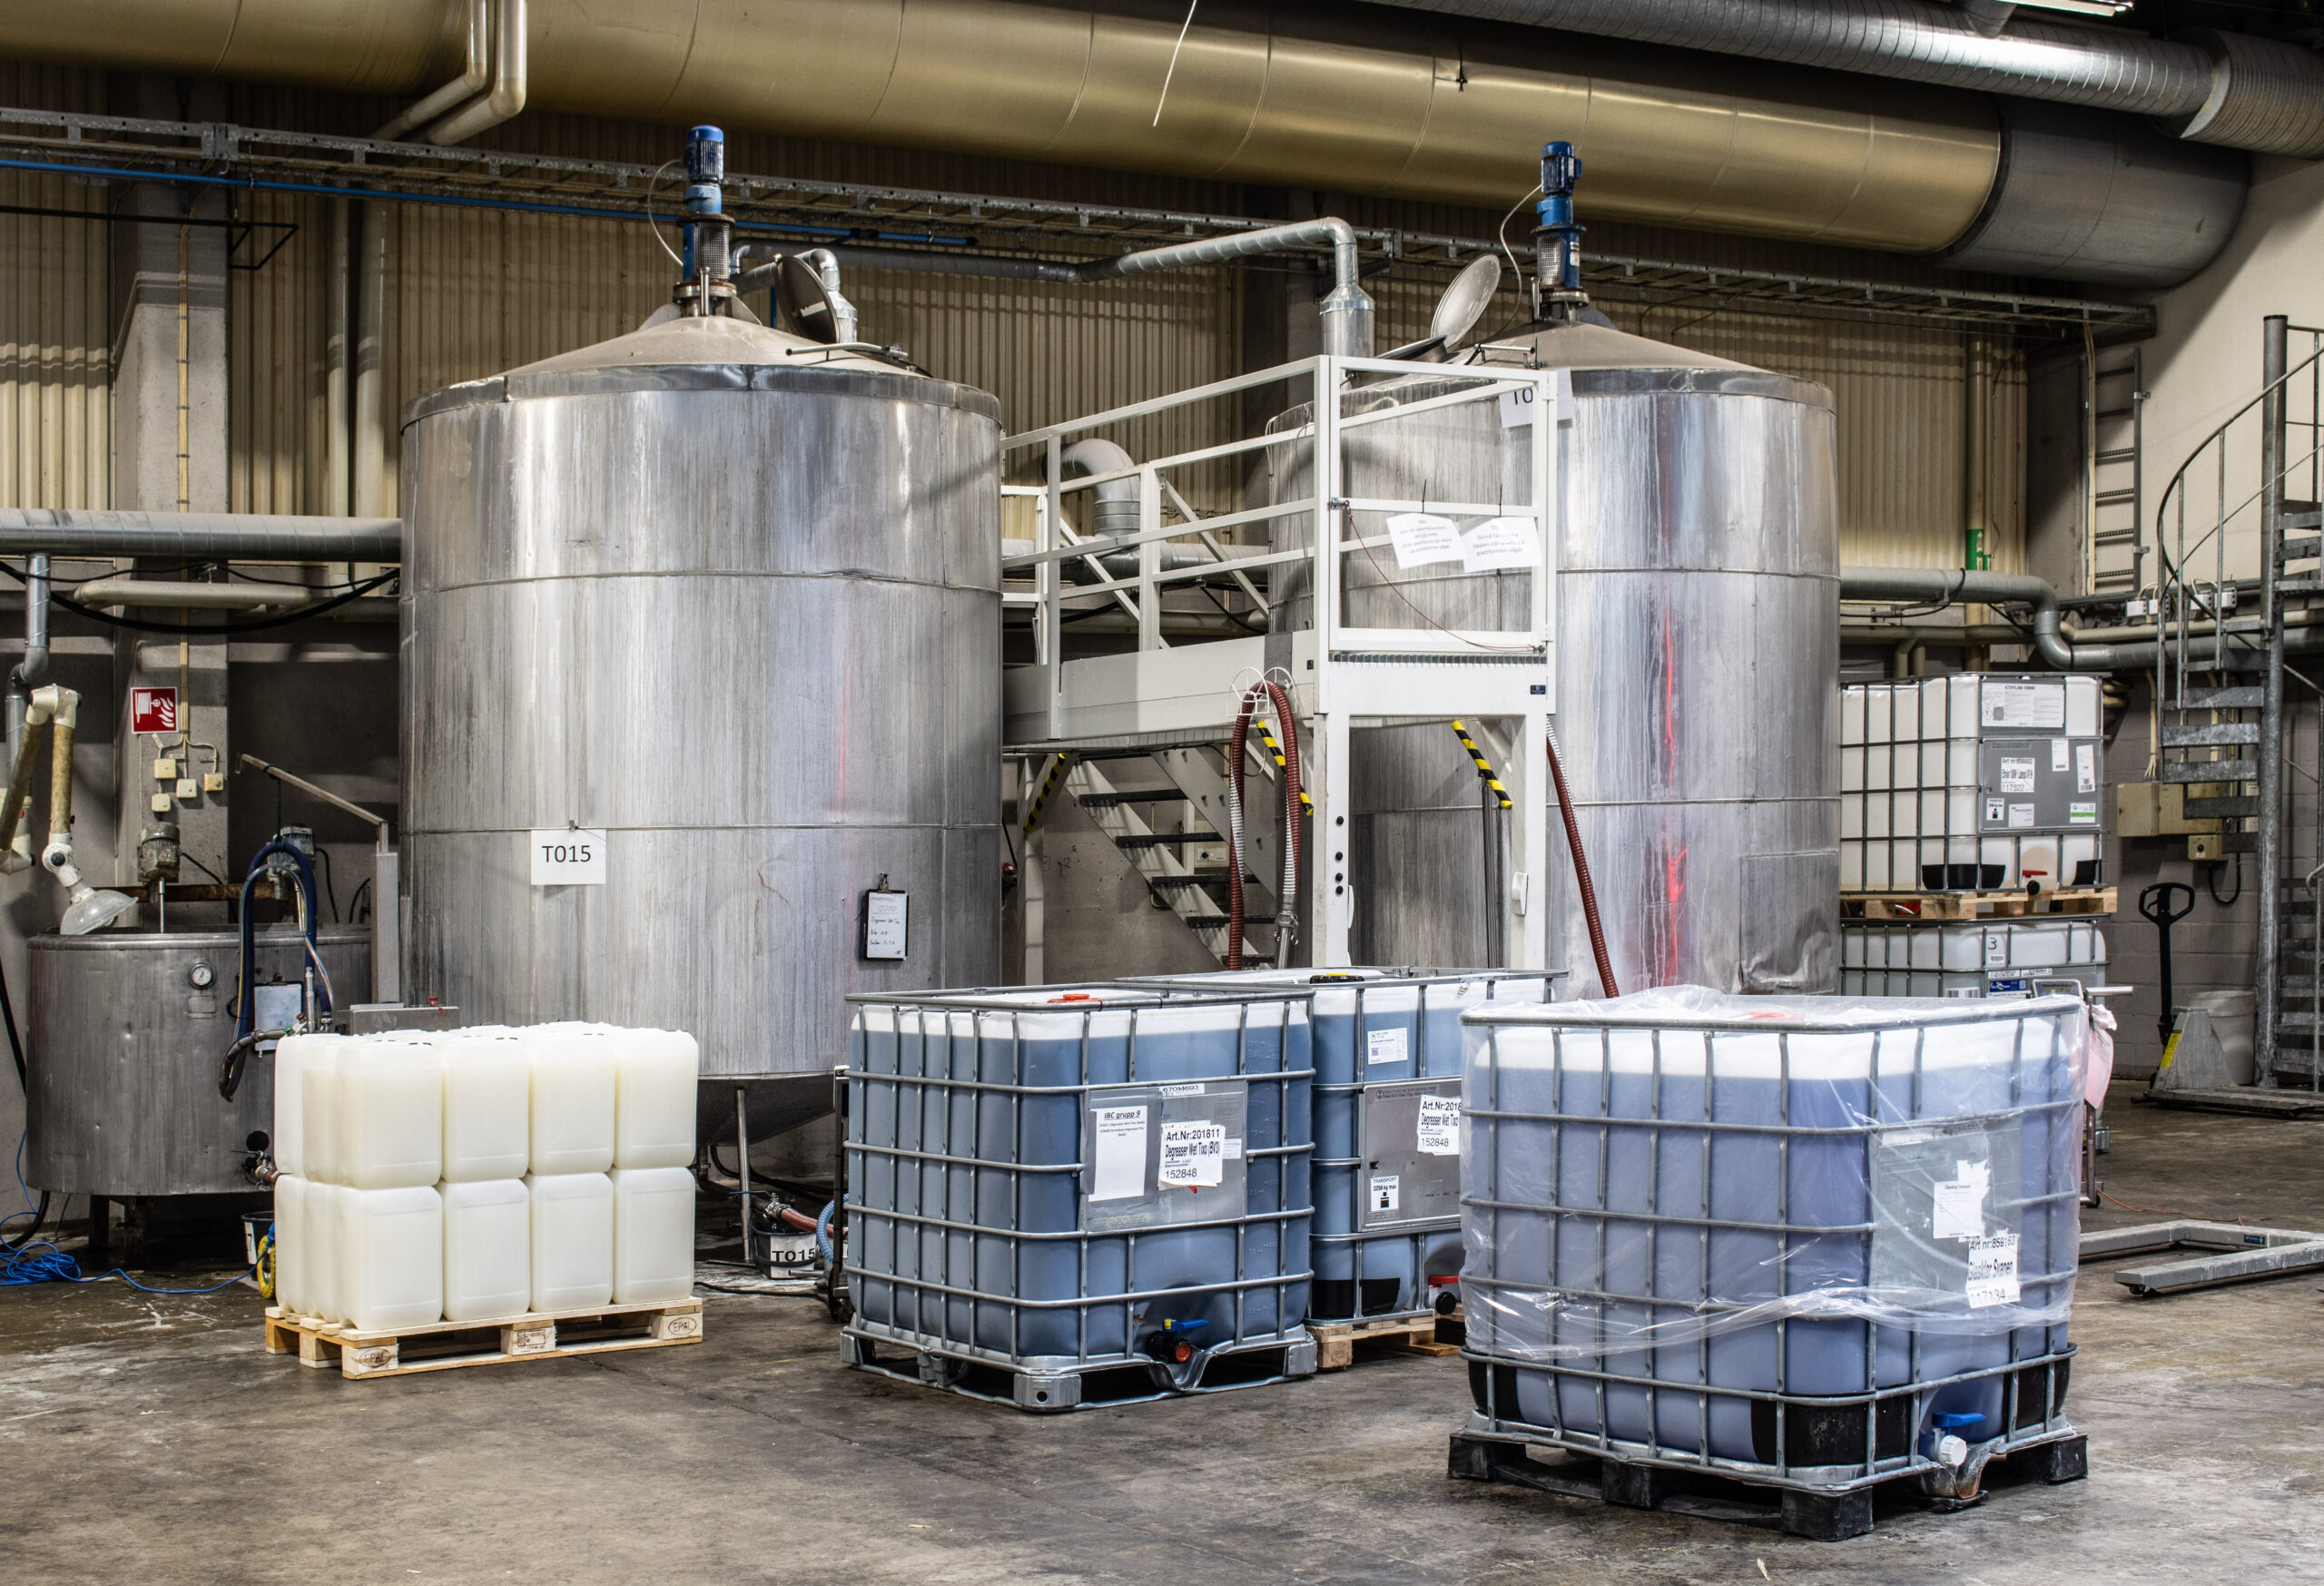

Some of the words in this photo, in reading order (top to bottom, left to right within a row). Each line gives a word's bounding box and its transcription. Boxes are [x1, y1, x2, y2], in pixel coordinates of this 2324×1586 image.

[541, 844, 591, 862] T015
[1988, 937, 1997, 951] 3
[1116, 1111, 1135, 1119] grupp
[1421, 1113, 1442, 1129] Degreaser
[1166, 1128, 1220, 1141] Art.Nr:201811
[1422, 1138, 1449, 1147] 152848
[1166, 1144, 1188, 1160] Degreaser
[1189, 1143, 1197, 1156] Wet
[1166, 1168, 1197, 1179] 152848
[1970, 1240, 1980, 1250] Art
[1968, 1259, 1993, 1281] Glasklar
[1994, 1257, 2013, 1278] Svanen
